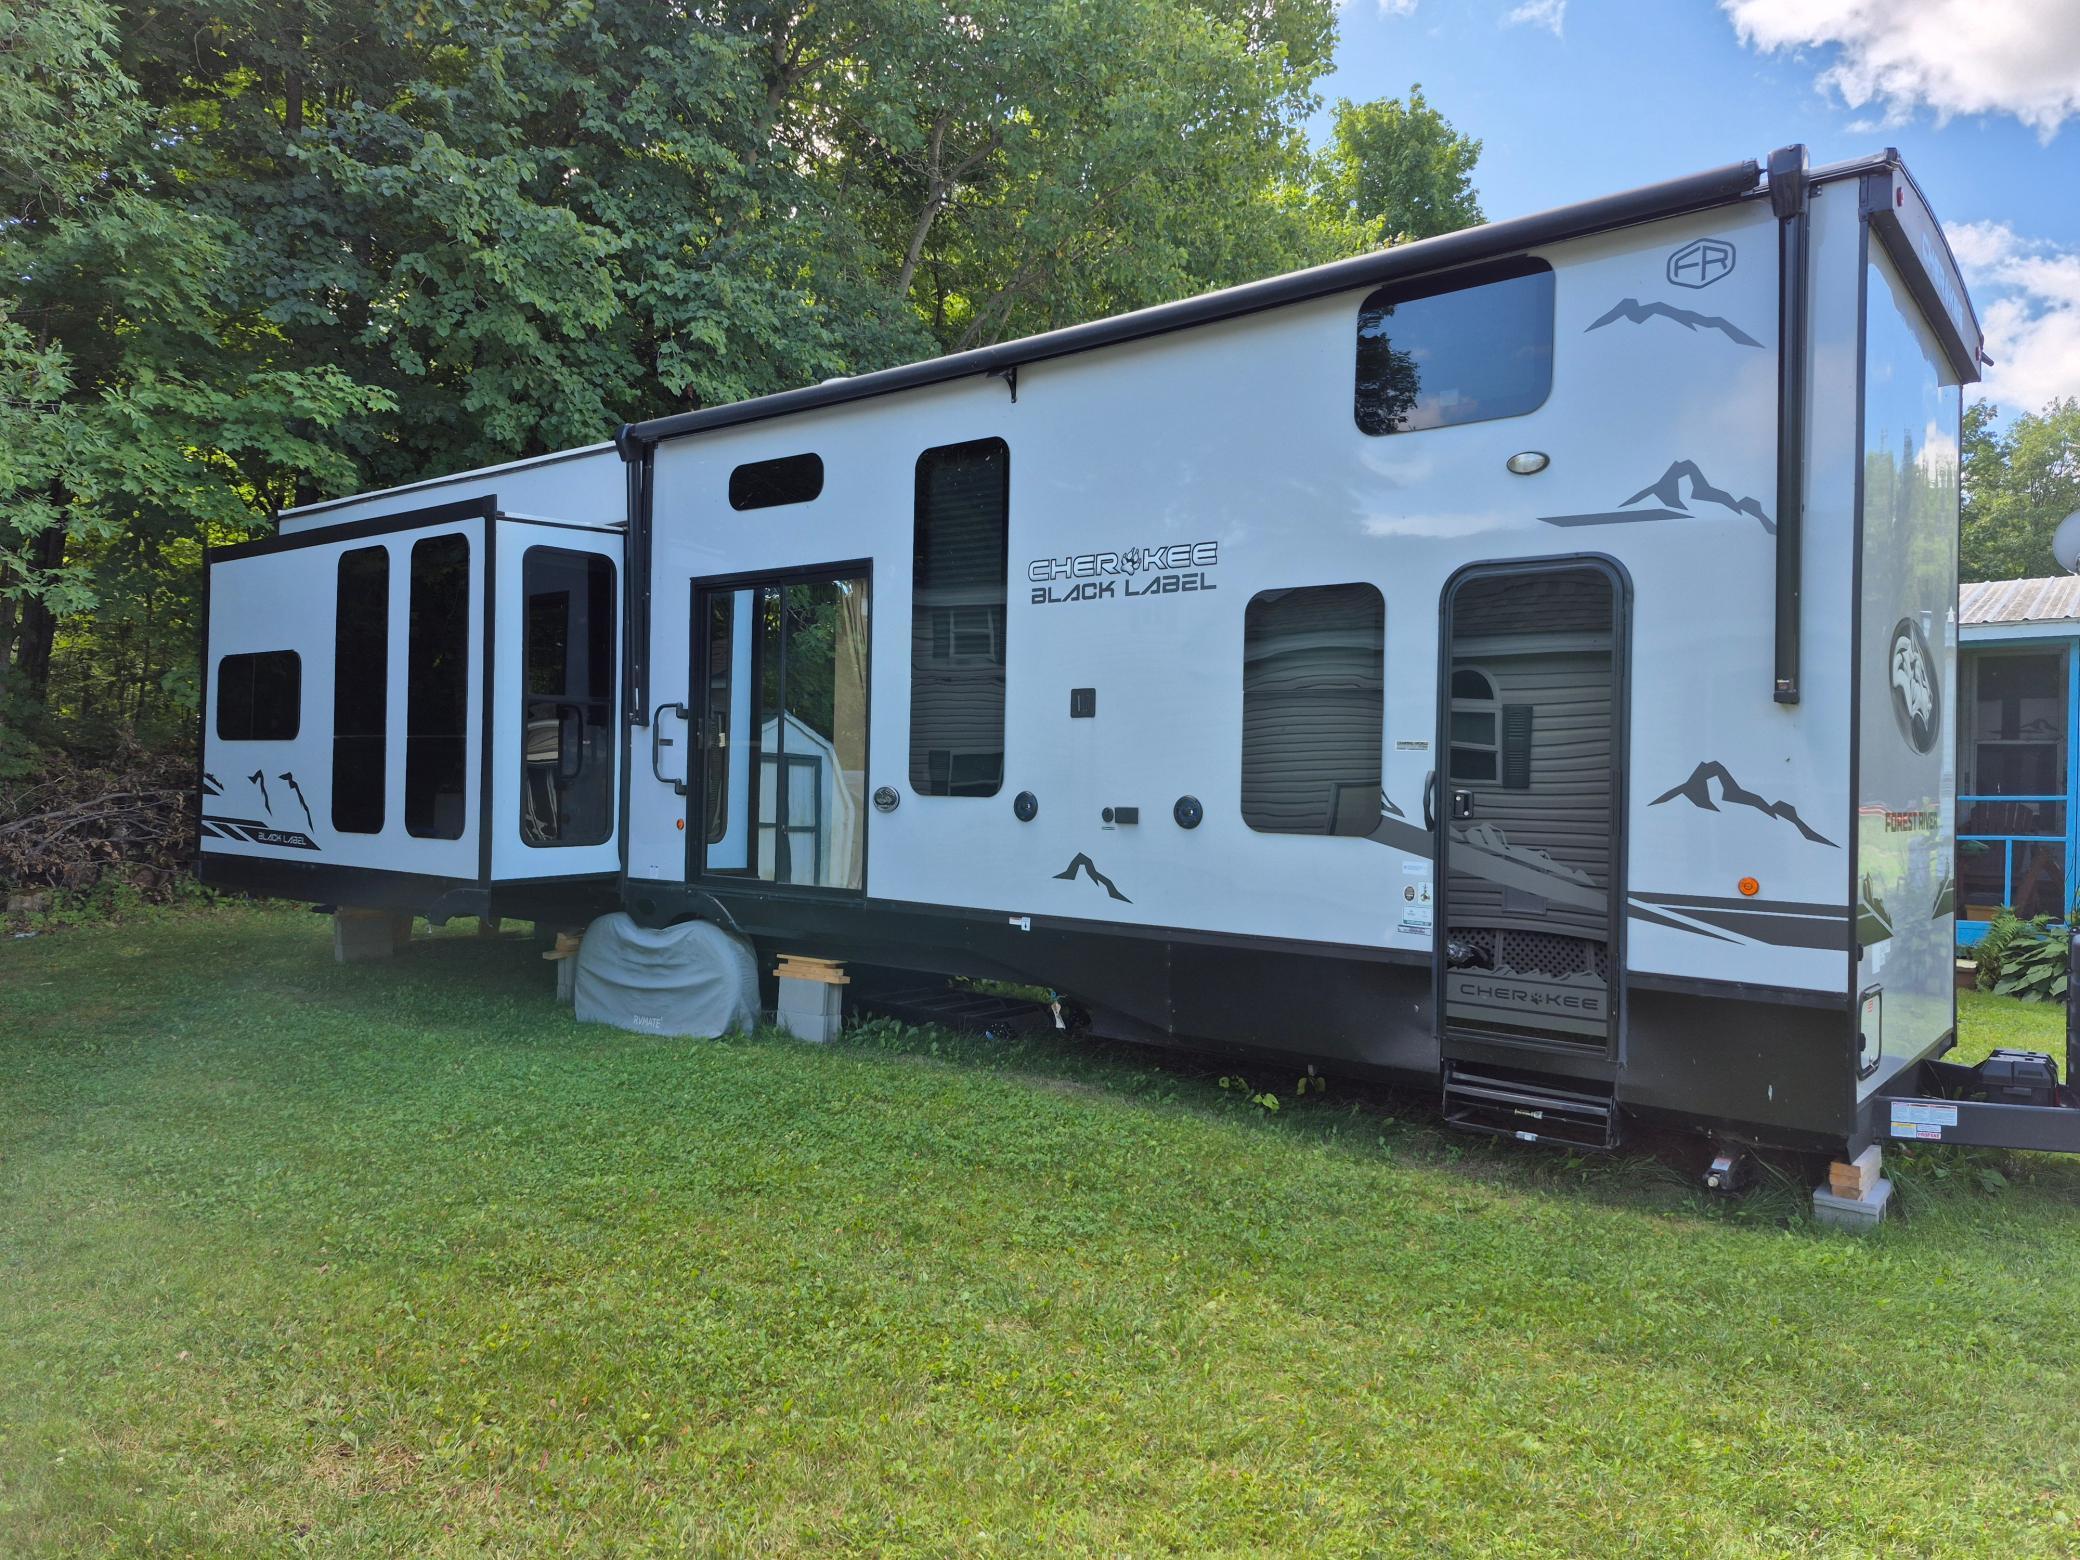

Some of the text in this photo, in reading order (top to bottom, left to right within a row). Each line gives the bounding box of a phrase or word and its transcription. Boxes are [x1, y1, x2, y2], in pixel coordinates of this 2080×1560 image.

[1031, 572, 1217, 604] BLACK LABEL
[1885, 811, 1938, 832] FOREST RIVER
[258, 832, 307, 846] BLACK LABEL
